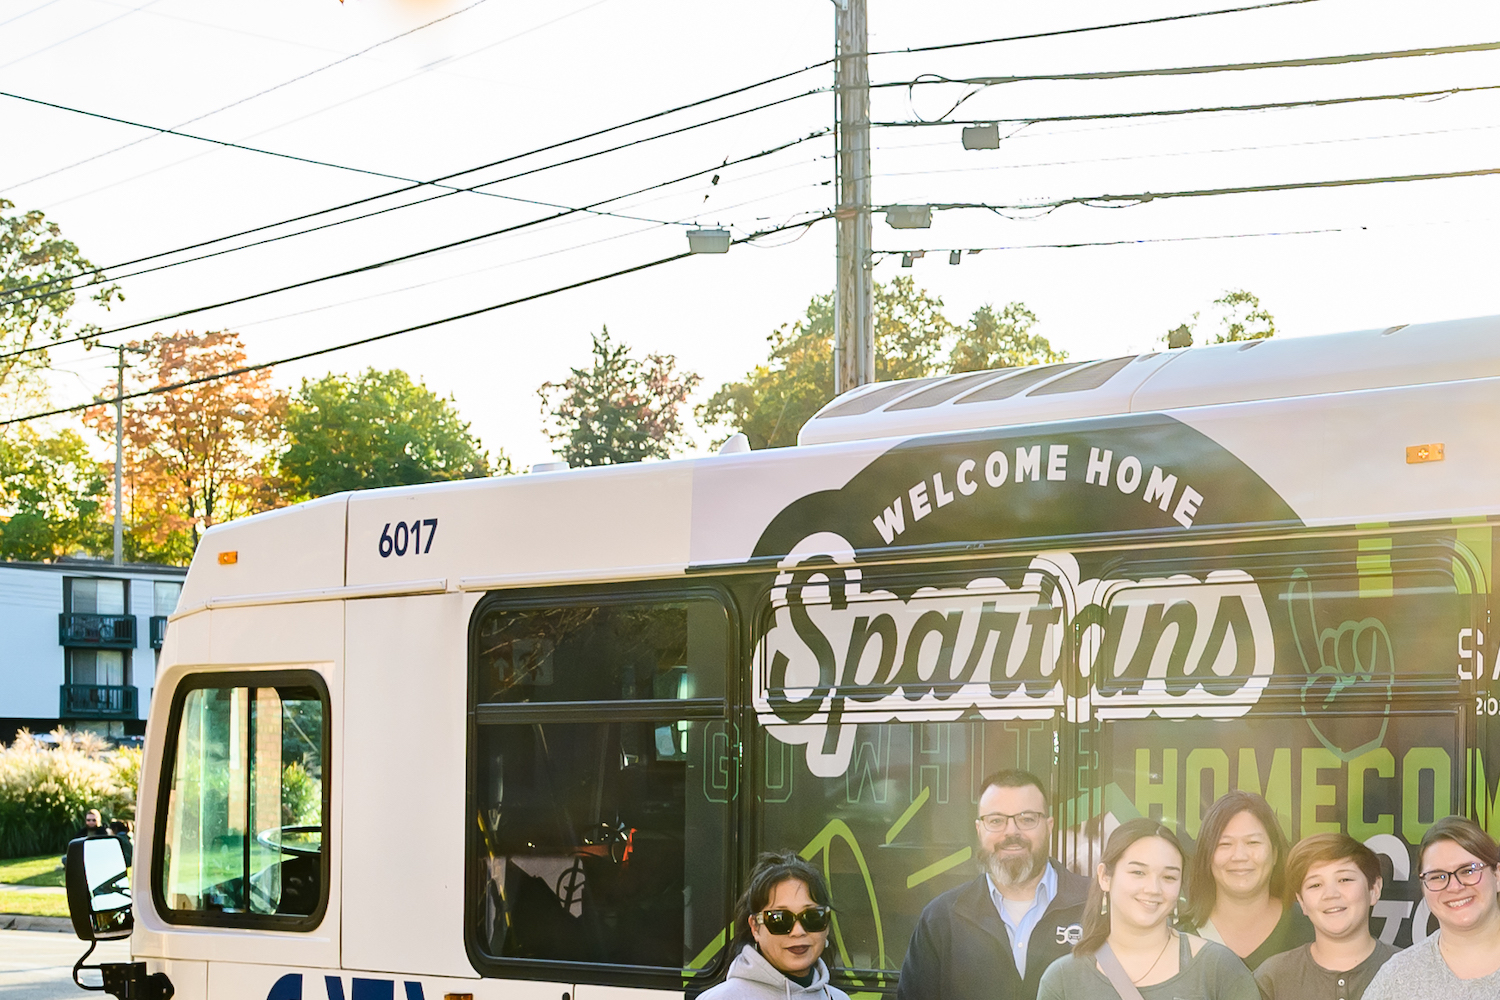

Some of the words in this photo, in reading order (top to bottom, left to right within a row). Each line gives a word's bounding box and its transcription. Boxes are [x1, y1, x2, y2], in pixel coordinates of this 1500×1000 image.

[378, 518, 438, 557] 6017
[873, 445, 1068, 544] WELCOME
[1085, 447, 1204, 529] HOME
[752, 532, 1275, 777] Spartans
